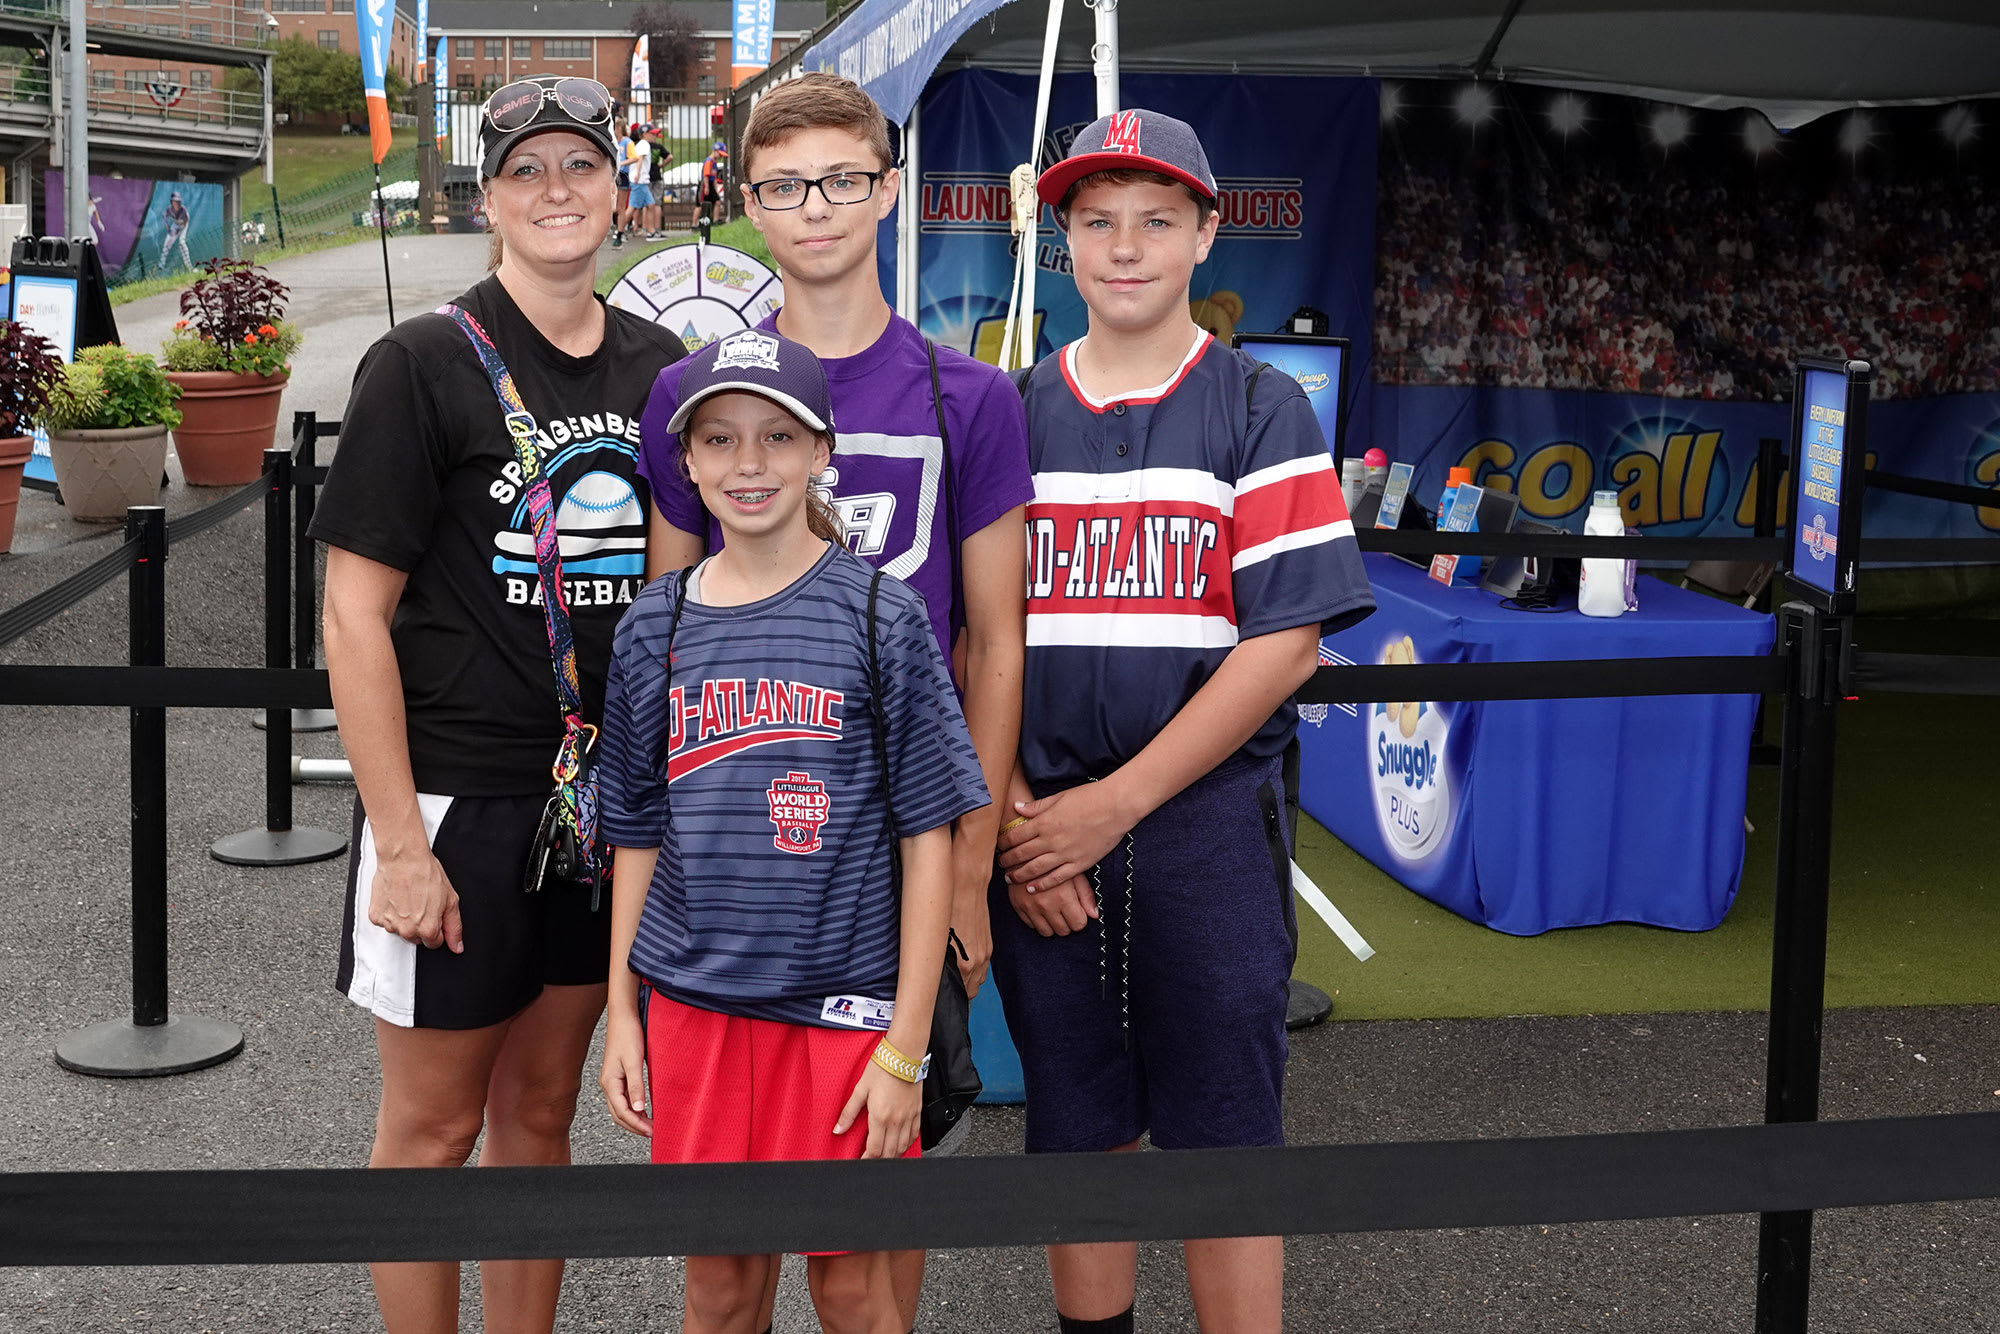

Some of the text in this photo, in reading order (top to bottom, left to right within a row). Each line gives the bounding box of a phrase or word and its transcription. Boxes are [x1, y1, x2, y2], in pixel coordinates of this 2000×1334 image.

[736, 0, 756, 60] FAM
[757, 0, 771, 61] FUN ZO
[1102, 110, 1141, 155] MA
[1214, 189, 1303, 228] DUCTS
[706, 265, 728, 281] all
[1037, 242, 1074, 276] Lit
[489, 412, 641, 504] SPNGENBE
[1611, 430, 1723, 528] all
[1026, 515, 1218, 600] D-ATLANTIC
[506, 576, 648, 606] BASEBA
[668, 678, 845, 755] D-ATLANTIC
[790, 775, 806, 783] 2017
[1378, 731, 1437, 790] Snuggle
[771, 793, 827, 807] WORLD
[773, 806, 825, 820] SERIES
[1391, 795, 1421, 836] PLUS
[781, 820, 815, 829] BASEBALL
[827, 1007, 857, 1018] RUSSELL
[876, 1008, 885, 1018] L
